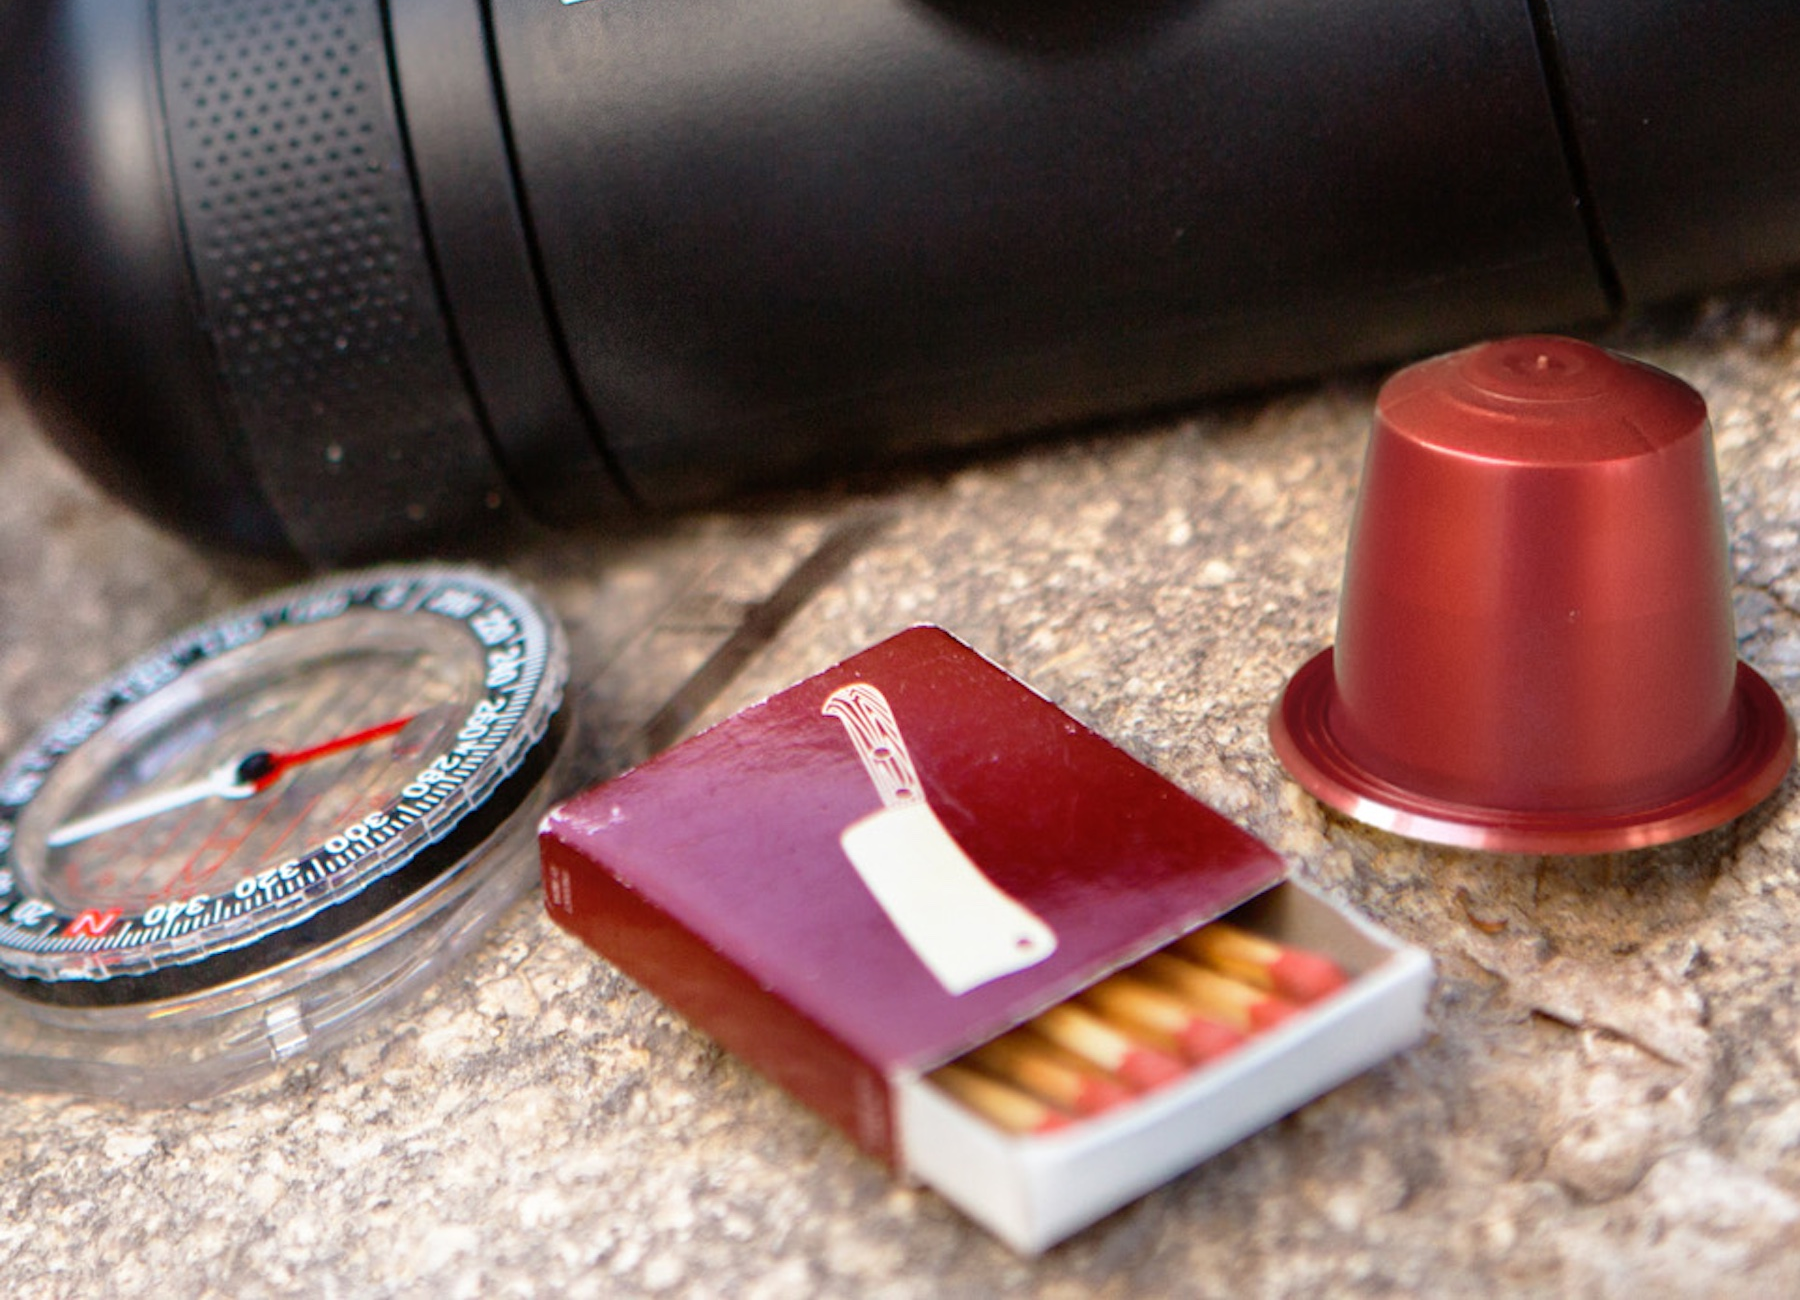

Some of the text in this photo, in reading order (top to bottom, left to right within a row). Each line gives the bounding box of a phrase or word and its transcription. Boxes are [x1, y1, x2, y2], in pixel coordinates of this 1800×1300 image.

[458, 697, 506, 741] 260
[403, 755, 460, 799] 280
[324, 811, 389, 854] 300
[234, 860, 300, 899] 320
[66, 910, 119, 936] N
[143, 895, 209, 926] 340
